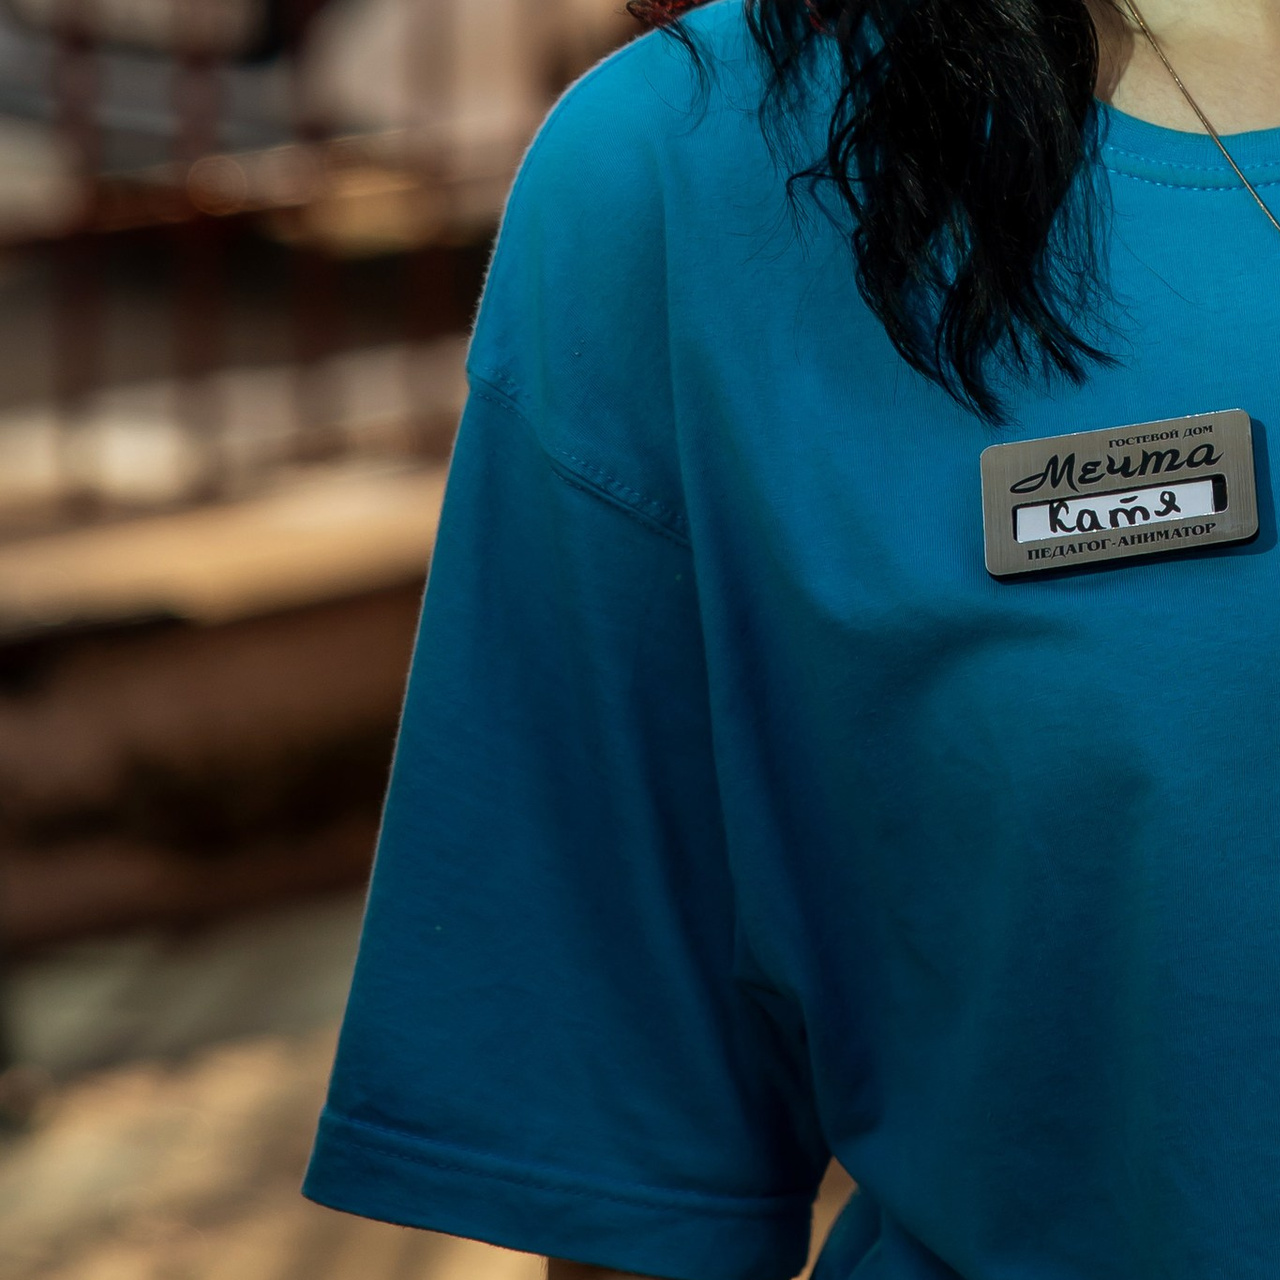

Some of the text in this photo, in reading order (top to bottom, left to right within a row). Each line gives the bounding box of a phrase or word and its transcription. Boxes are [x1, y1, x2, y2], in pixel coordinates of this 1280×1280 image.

[1108, 424, 1213, 448] ГОСТЕВОЙ ДОМ
[1009, 442, 1224, 494] Мечта
[1049, 490, 1181, 534] Катя
[1027, 522, 1217, 561] ПЕДАГОГ-АНИМАТОР
